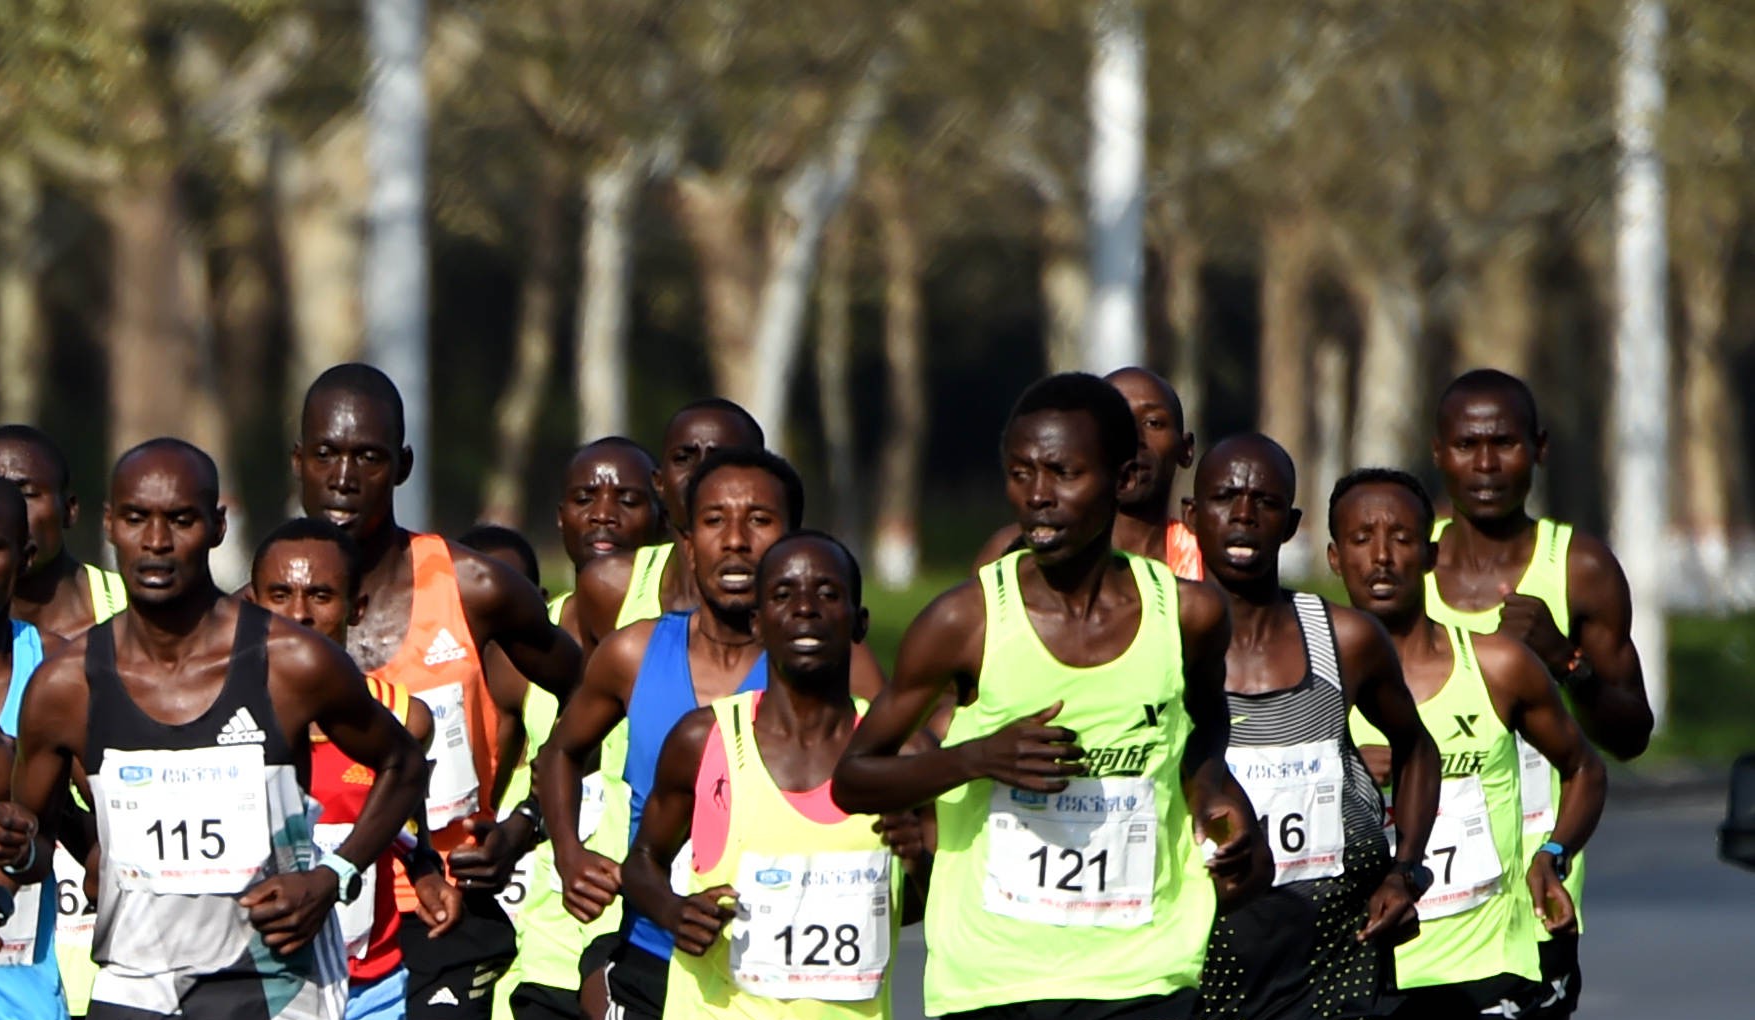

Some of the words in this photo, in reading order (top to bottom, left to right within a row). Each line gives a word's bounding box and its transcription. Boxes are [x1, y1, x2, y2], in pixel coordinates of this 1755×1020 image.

[217, 730, 266, 746] adidas
[146, 819, 226, 861] 115
[1029, 845, 1108, 893] 121
[774, 923, 861, 967] 128
